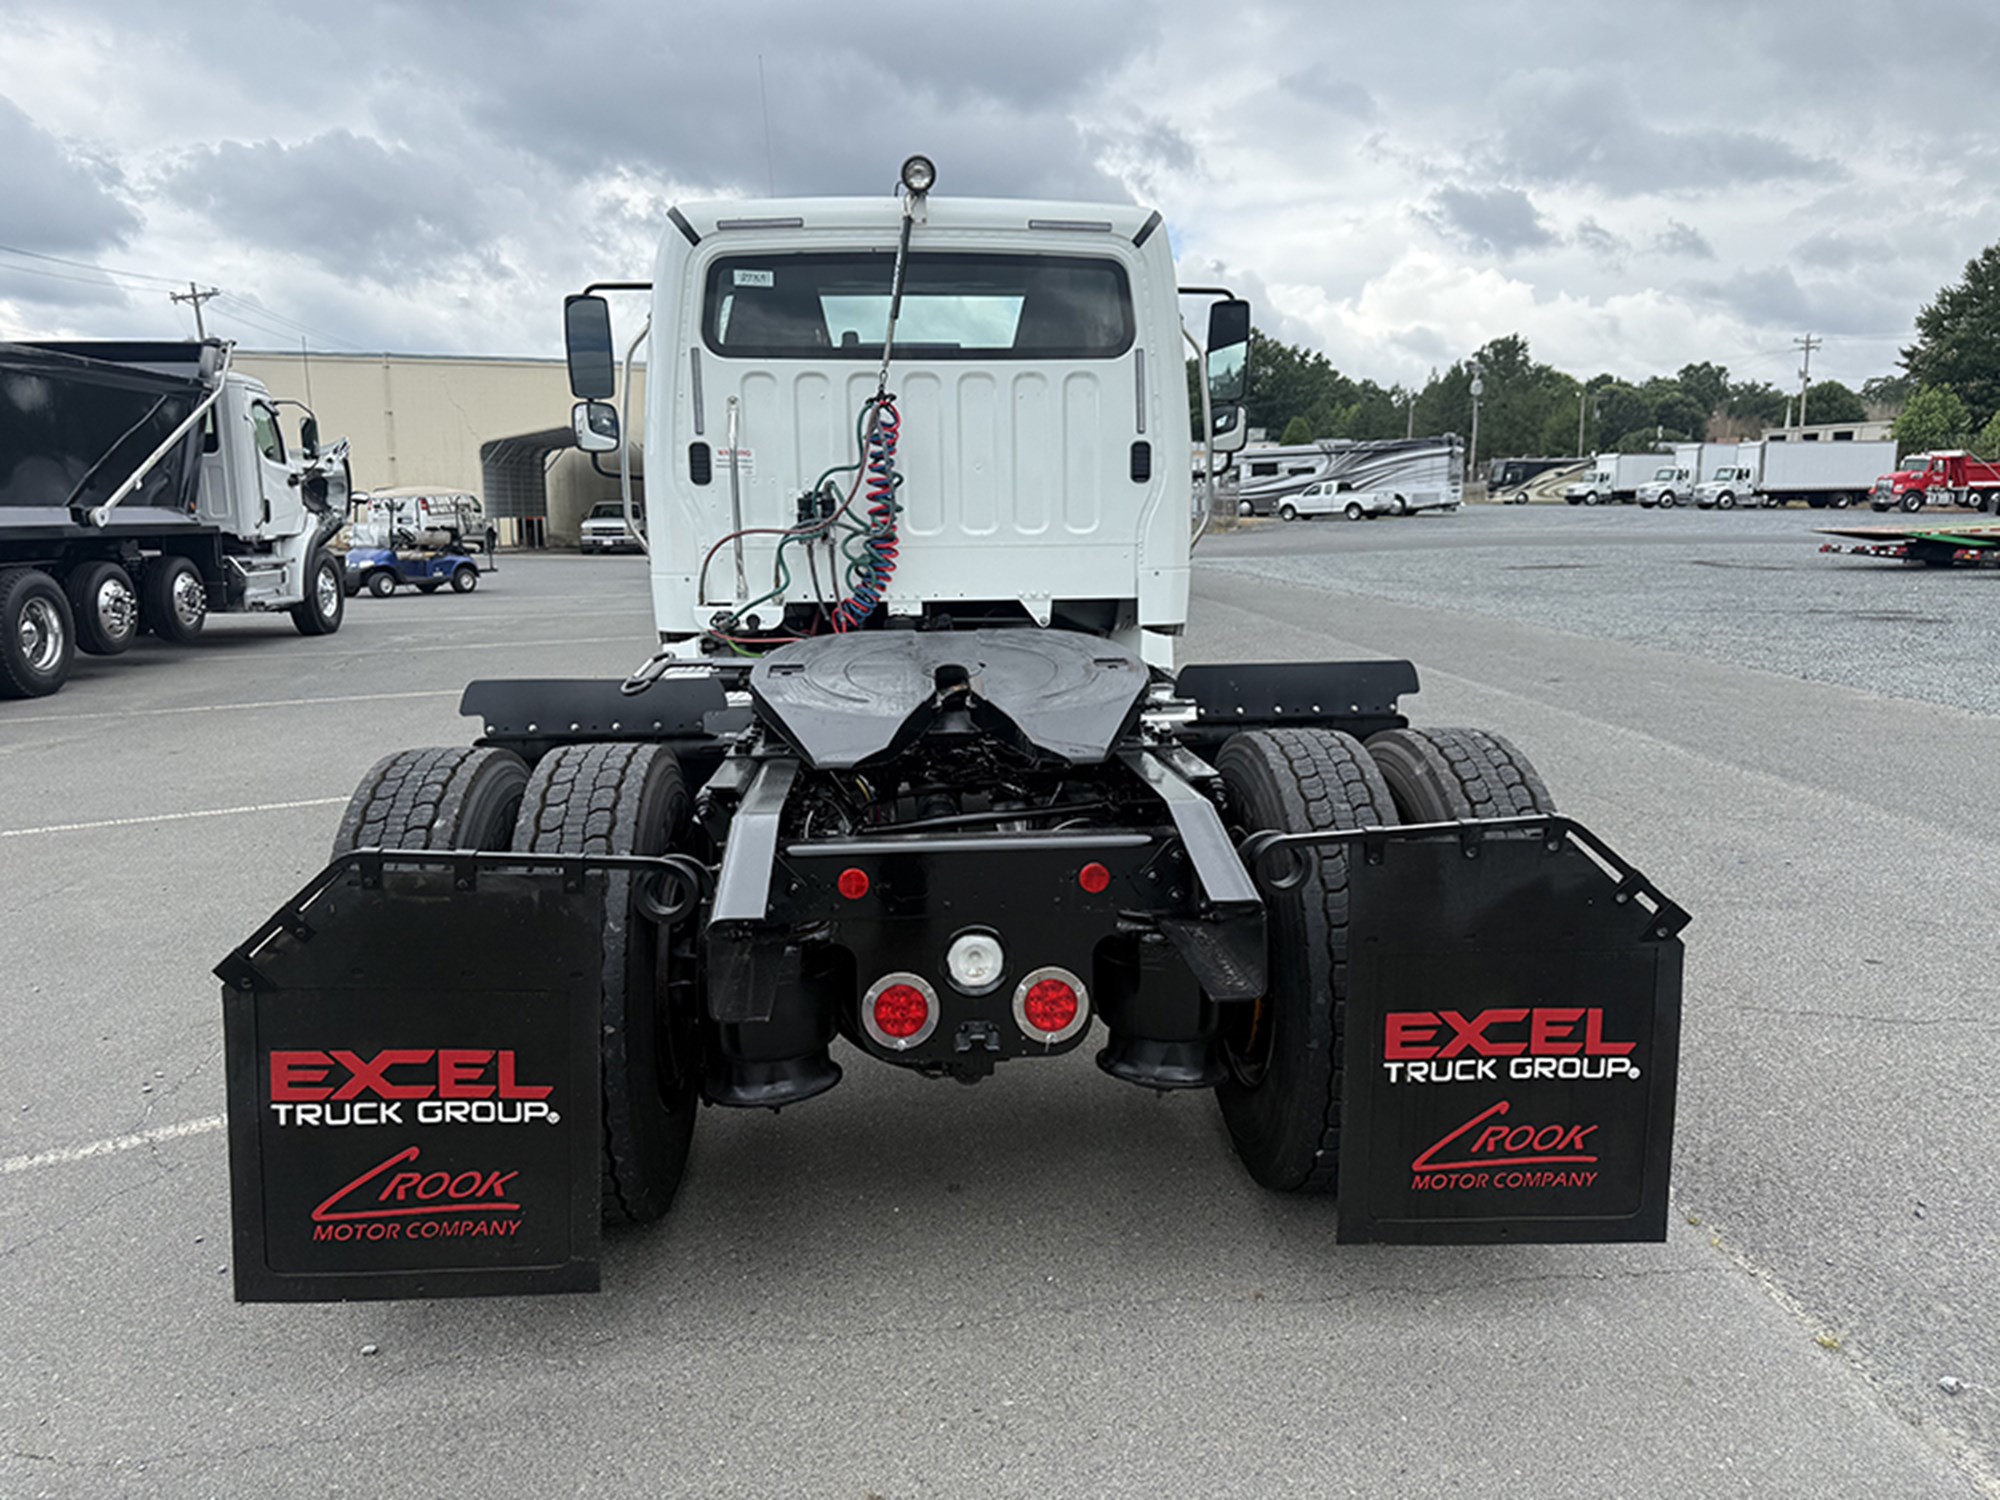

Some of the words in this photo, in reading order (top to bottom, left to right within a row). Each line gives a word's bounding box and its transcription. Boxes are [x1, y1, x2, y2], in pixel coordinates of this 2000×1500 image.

[1384, 1008, 1637, 1060] EXCEL
[269, 1049, 554, 1101] EXCEL
[1384, 1058, 1498, 1083] TRUCK
[270, 1101, 403, 1126] TRUCK
[1411, 1173, 1489, 1190] MOTOR
[1493, 1171, 1599, 1189] COMPANY
[312, 1223, 401, 1241] MOTOR
[405, 1220, 522, 1240] COMPANY
